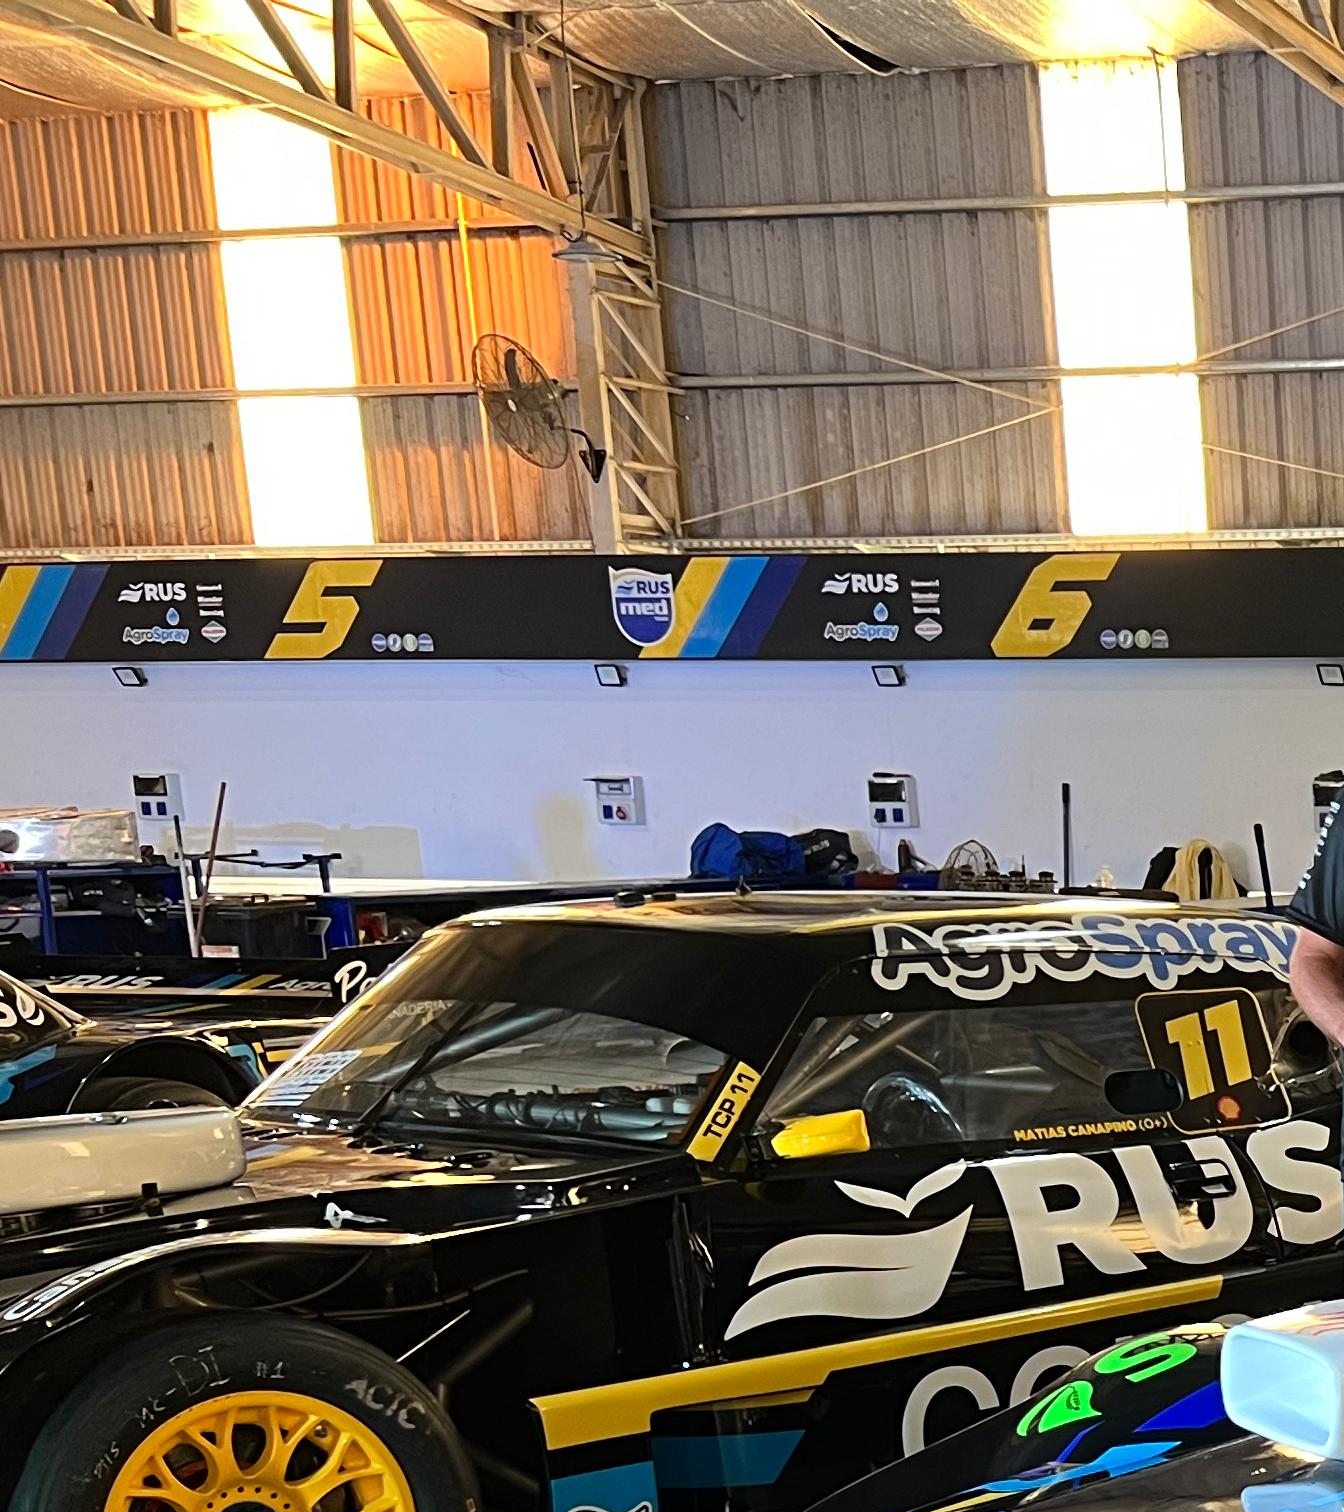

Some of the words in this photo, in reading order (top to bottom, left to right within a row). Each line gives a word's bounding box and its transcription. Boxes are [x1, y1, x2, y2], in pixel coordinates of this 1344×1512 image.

[144, 583, 187, 601] RUS
[637, 581, 670, 594] RUS
[851, 574, 899, 593] RUS
[266, 561, 382, 657] 5
[620, 599, 669, 616] med
[991, 554, 1121, 656] 6
[123, 626, 190, 644] AgroSpray
[824, 622, 899, 641] AgroSpray
[1165, 1000, 1253, 1100] 11
[703, 1099, 737, 1141] TCP
[730, 1073, 756, 1094] 11
[1014, 1124, 1066, 1142] MATIAS
[1068, 1119, 1137, 1139] CANAPINO
[984, 1120, 1344, 1291] RUS
